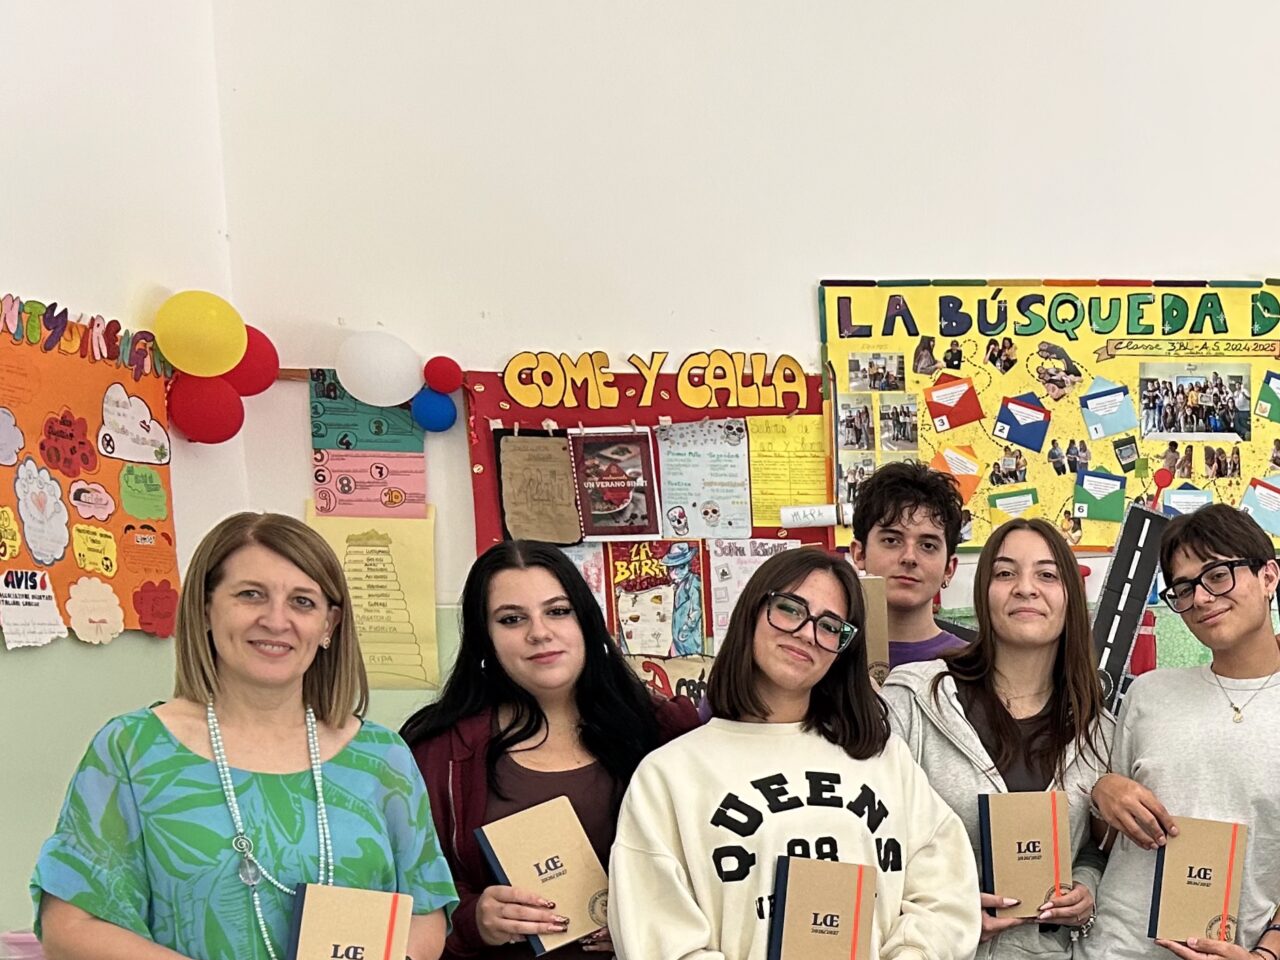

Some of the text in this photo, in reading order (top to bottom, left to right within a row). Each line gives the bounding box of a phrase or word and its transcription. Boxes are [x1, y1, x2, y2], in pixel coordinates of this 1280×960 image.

[836, 294, 920, 338] LA
[939, 288, 1229, 341] BÚSQUEDA
[1114, 341, 1162, 351] Classe
[504, 349, 808, 410] COME Y CALLA
[311, 422, 324, 438] 2
[373, 420, 384, 435] 3
[937, 417, 947, 428] 3
[998, 424, 1006, 434] 2
[339, 433, 352, 449] 4
[314, 469, 326, 483] 6
[374, 465, 384, 478] 7
[339, 476, 353, 494] 8
[596, 480, 626, 488] VERANO
[318, 489, 331, 512] 9
[384, 488, 403, 505] 10
[791, 509, 824, 522] MAPA
[1077, 505, 1085, 514] 6
[629, 541, 653, 562] LA
[4, 570, 38, 590] AVIS
[710, 770, 903, 883] QUEENS
